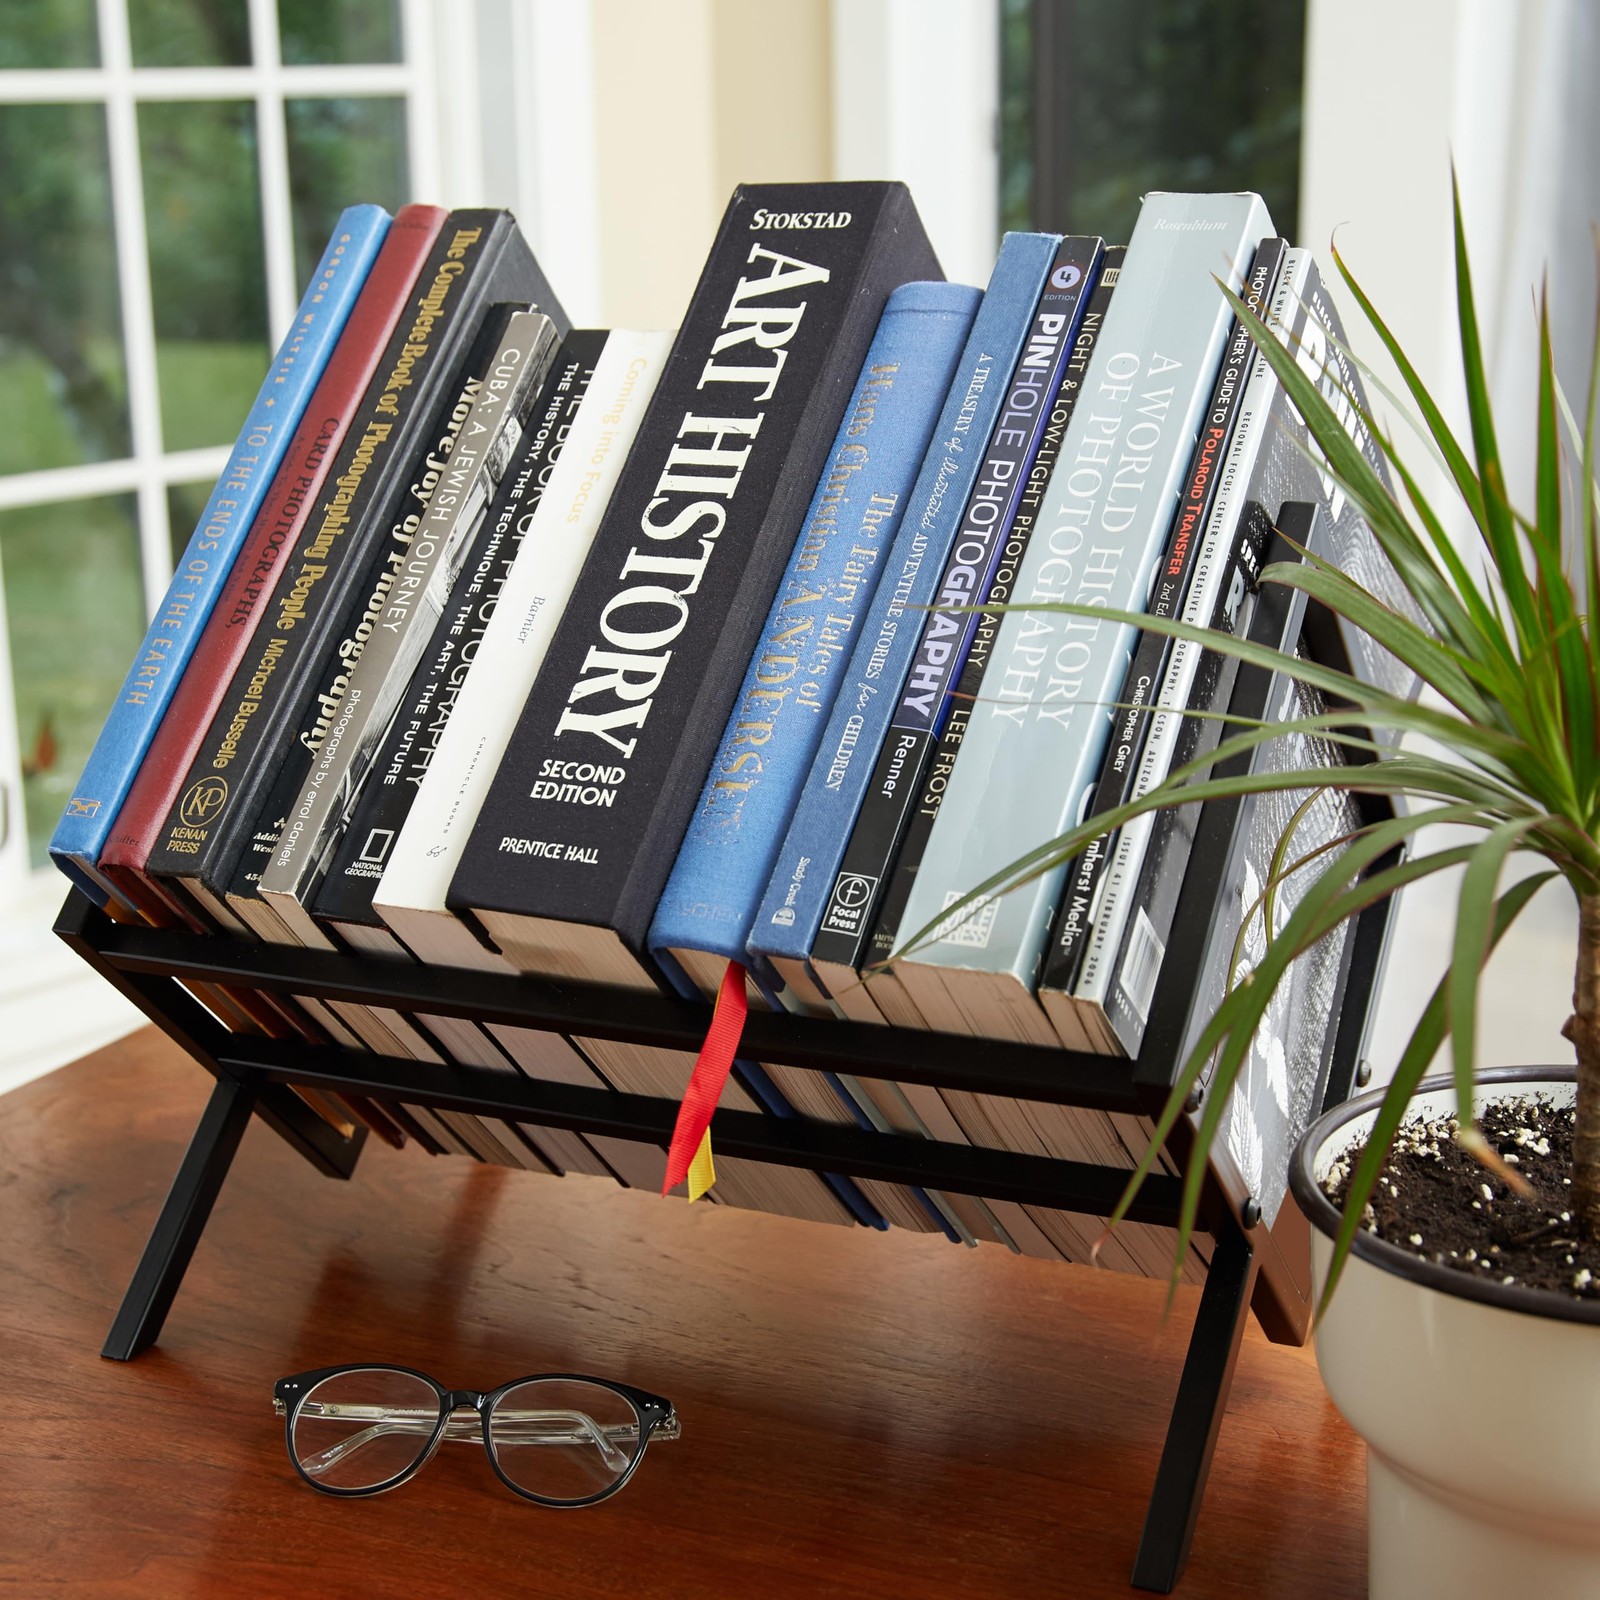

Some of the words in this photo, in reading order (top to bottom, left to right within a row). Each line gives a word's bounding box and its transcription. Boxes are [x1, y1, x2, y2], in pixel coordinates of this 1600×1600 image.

[447, 226, 483, 259] The
[749, 208, 852, 230] STOKSTAD
[1153, 219, 1229, 231] Rosenblum
[312, 233, 351, 304] GORDON
[1281, 259, 1296, 286] BLACK
[408, 261, 465, 343] Complete
[1043, 293, 1077, 301] EDITION
[1270, 299, 1284, 326] WHITE
[696, 243, 831, 402] ART
[1068, 312, 1102, 373] NIGHT
[275, 313, 315, 384] WILTSIE
[385, 342, 430, 392] Book
[978, 352, 994, 363] A
[1146, 352, 1183, 378] A
[477, 348, 521, 415] CUBA:
[557, 362, 580, 392] THE
[602, 357, 648, 426] Coming
[846, 361, 901, 438] Hans
[953, 366, 991, 435] TREASURY
[994, 313, 1067, 448] PINHOLE
[1060, 379, 1078, 391] &
[1098, 352, 1140, 403] OF
[1217, 367, 1239, 405] GUIDE
[374, 392, 400, 417] of
[1212, 406, 1228, 424] TO
[246, 423, 273, 447] TO
[304, 417, 340, 470] CARD
[467, 420, 487, 437] A
[523, 396, 565, 463] HISTORY,
[591, 431, 620, 465] into
[943, 436, 964, 454] of
[1232, 411, 1252, 457] REGIONAL
[225, 455, 260, 492] THE
[1022, 399, 1073, 507] LOW-LIGHT
[1101, 386, 1175, 533] WORLD
[1190, 428, 1225, 499] POLAROID
[303, 420, 394, 559] Photographing
[430, 444, 478, 521] JEWISH
[510, 468, 533, 499] THE
[566, 471, 602, 524] Focus
[921, 456, 959, 529] illustrated
[1221, 463, 1238, 496] FOCUS:
[197, 498, 237, 550] ENDS
[795, 443, 870, 572] Christian
[858, 491, 899, 539] The
[1210, 501, 1227, 536] CENTER
[225, 476, 314, 629] PHOTOGRAPHS,
[464, 503, 518, 598] TECHNIQUE,
[1167, 503, 1204, 576] TRANSFER
[1203, 541, 1216, 559] FOR
[183, 560, 209, 585] OF
[276, 562, 329, 630] People
[382, 529, 440, 634] JOURNEY
[554, 411, 765, 759] HISTORY
[828, 543, 880, 610] Fairy
[887, 531, 929, 618] ADVENTURE
[903, 459, 1016, 719] PHOTOGRAPHY
[1160, 582, 1175, 601] 2nd
[1188, 565, 1209, 612] CREATIVE
[161, 591, 195, 631] THE
[449, 603, 474, 636] THE
[517, 595, 546, 644] Barnier
[429, 640, 456, 676] ART,
[808, 612, 856, 676] Tales
[865, 620, 898, 679] STORIES
[125, 637, 173, 705] EARTH
[244, 638, 289, 703] Michael
[414, 682, 439, 715] THE
[796, 680, 823, 713] of
[858, 682, 879, 712] for
[212, 701, 260, 769] Busselle
[319, 688, 362, 771] photographs
[944, 709, 971, 744] LEE
[1149, 701, 1171, 744] TCSON,
[383, 720, 422, 786] FUTURE
[459, 736, 486, 794] CHRONICLE
[538, 759, 626, 785] SECOND
[824, 714, 864, 792] CHILDREN
[881, 734, 918, 799] Renner
[1113, 744, 1131, 773] GREY
[1136, 750, 1156, 798] ARIZONA
[310, 771, 329, 790] by
[530, 780, 617, 808] EDITION
[920, 752, 957, 820] FROST
[299, 791, 317, 820] errol
[443, 801, 460, 834] BOOKS
[166, 839, 200, 854] PRESS
[170, 826, 208, 841] KENAN
[276, 821, 305, 867] daniels
[498, 836, 565, 860] PRENTICE
[563, 846, 599, 864] HALL
[1116, 836, 1133, 867] ISSUE
[344, 867, 386, 879] GEOGRAPHIC
[351, 861, 384, 872] NATIONAL
[791, 855, 811, 882] Sandy
[1077, 833, 1109, 892] mherst
[828, 915, 857, 930] Press
[832, 905, 861, 920] Focal
[1060, 895, 1089, 946] Media
[1096, 892, 1117, 949] FEBRUARY
